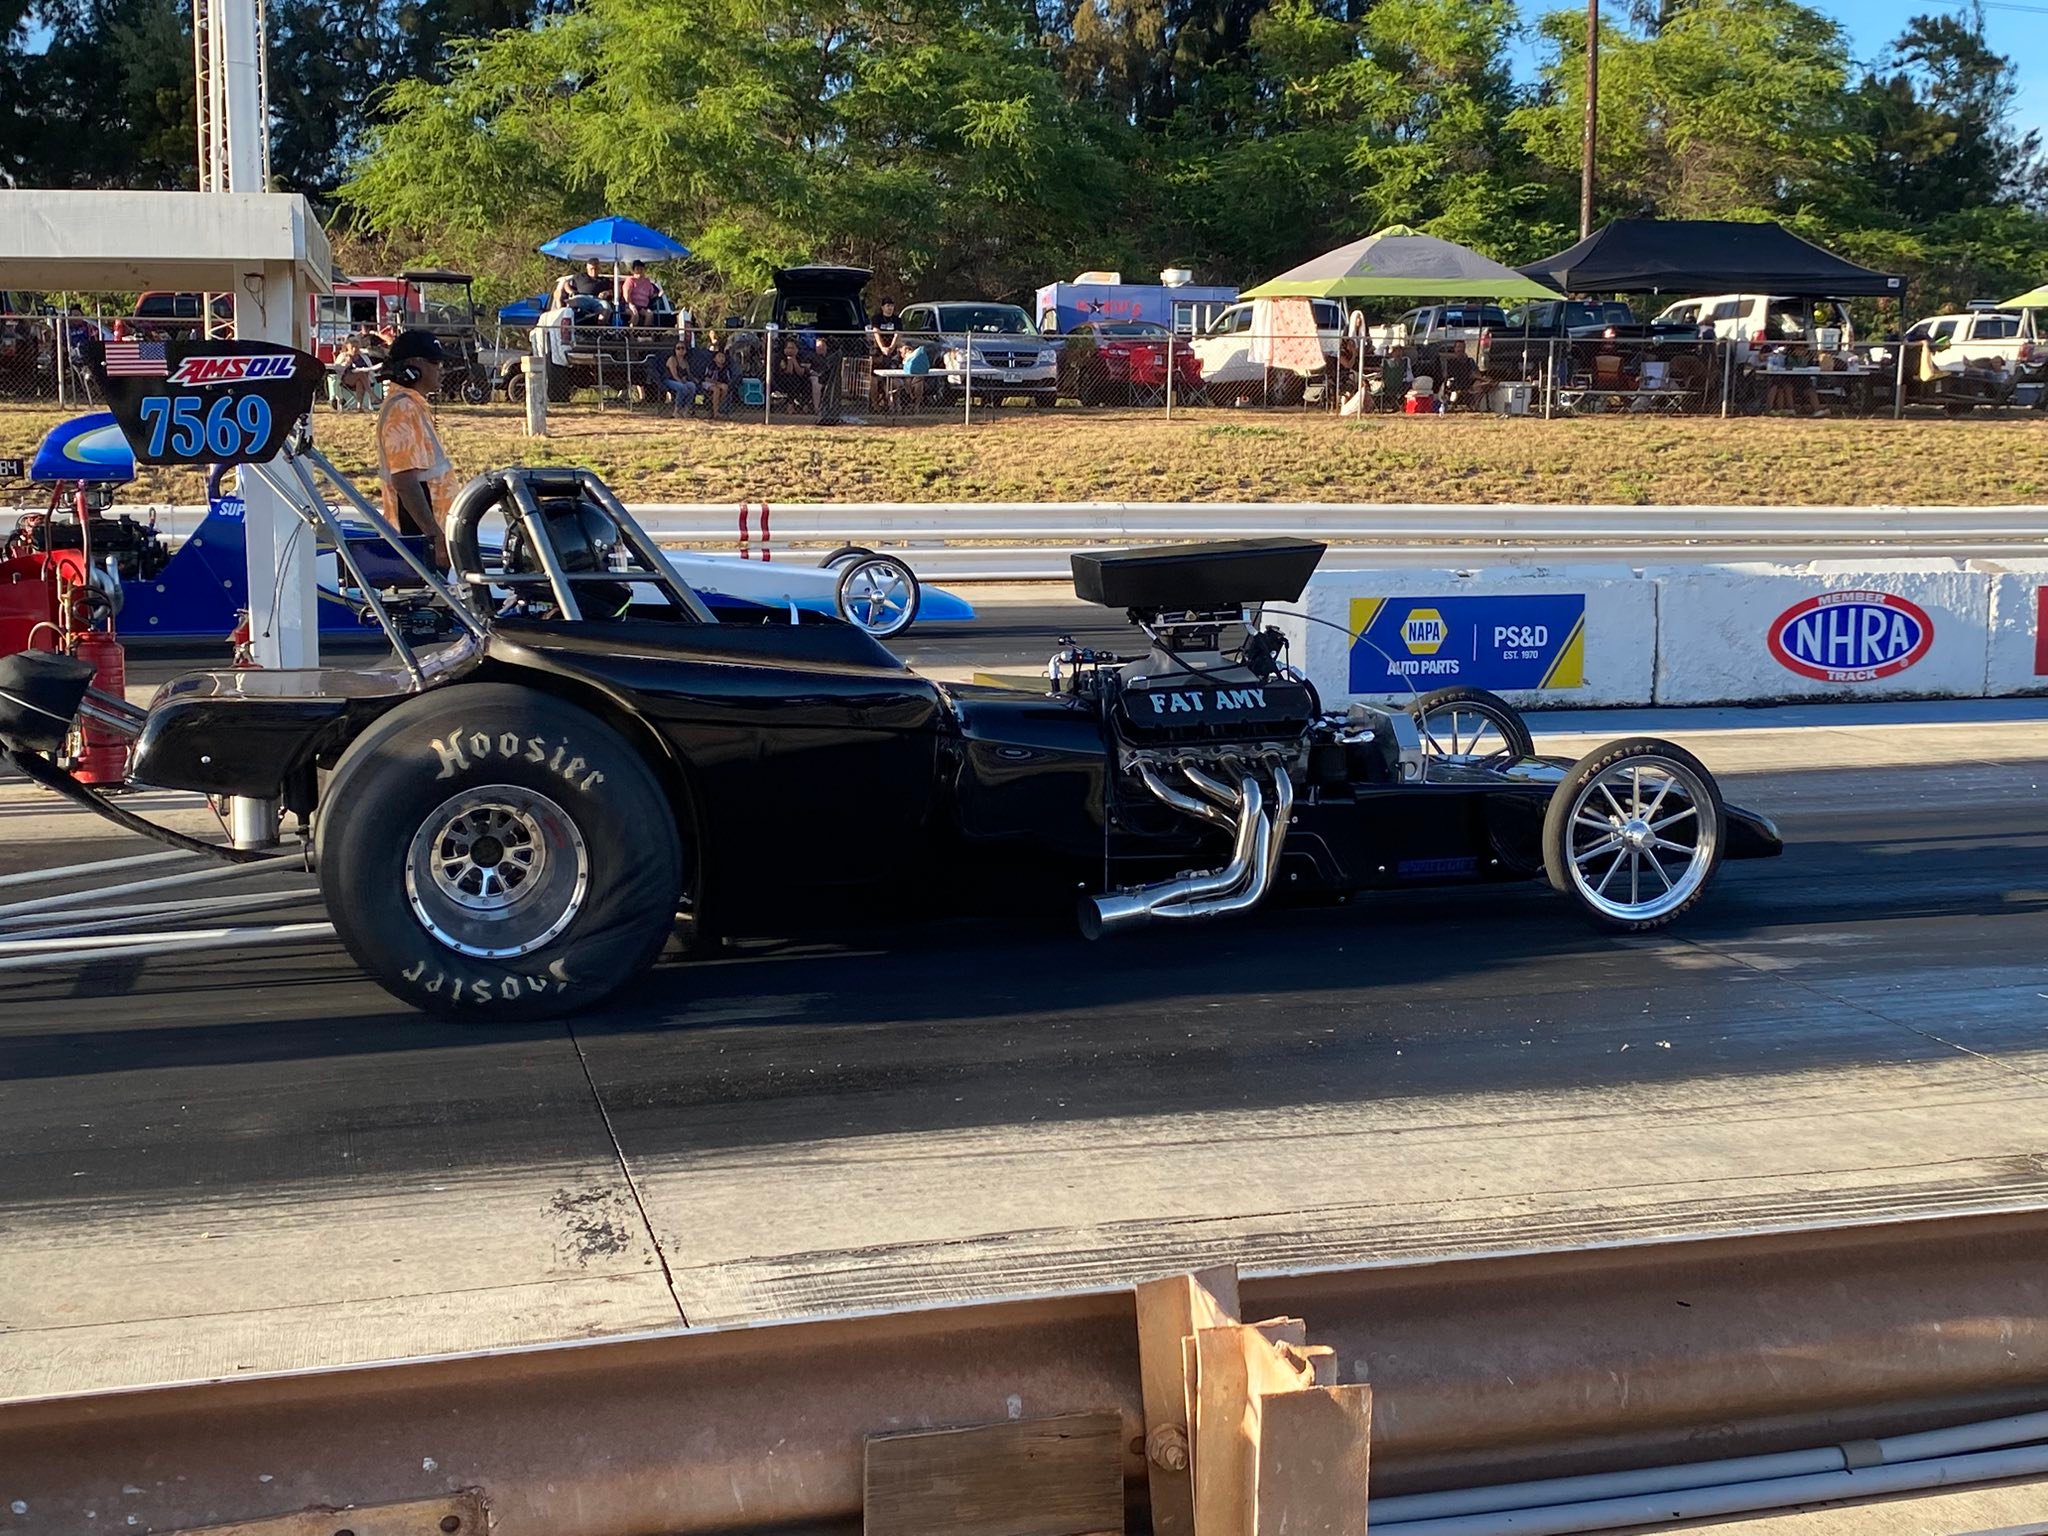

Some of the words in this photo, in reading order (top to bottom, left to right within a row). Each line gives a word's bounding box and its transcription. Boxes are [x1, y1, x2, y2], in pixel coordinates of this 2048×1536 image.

[168, 355, 296, 386] AMSOIL
[140, 394, 272, 457] 7569
[1818, 592, 1886, 607] MEMBER
[1408, 621, 1441, 642] NAPA
[1494, 625, 1548, 648] PS&D
[1796, 607, 1910, 665] NHRA
[1503, 650, 1519, 660] EST.
[1521, 650, 1539, 660] 1970
[1387, 660, 1419, 675] AUTO
[1421, 660, 1459, 674] PARTS
[1826, 669, 1878, 682] TRACK
[1150, 691, 1204, 714] FAT
[1216, 688, 1267, 710] AMY
